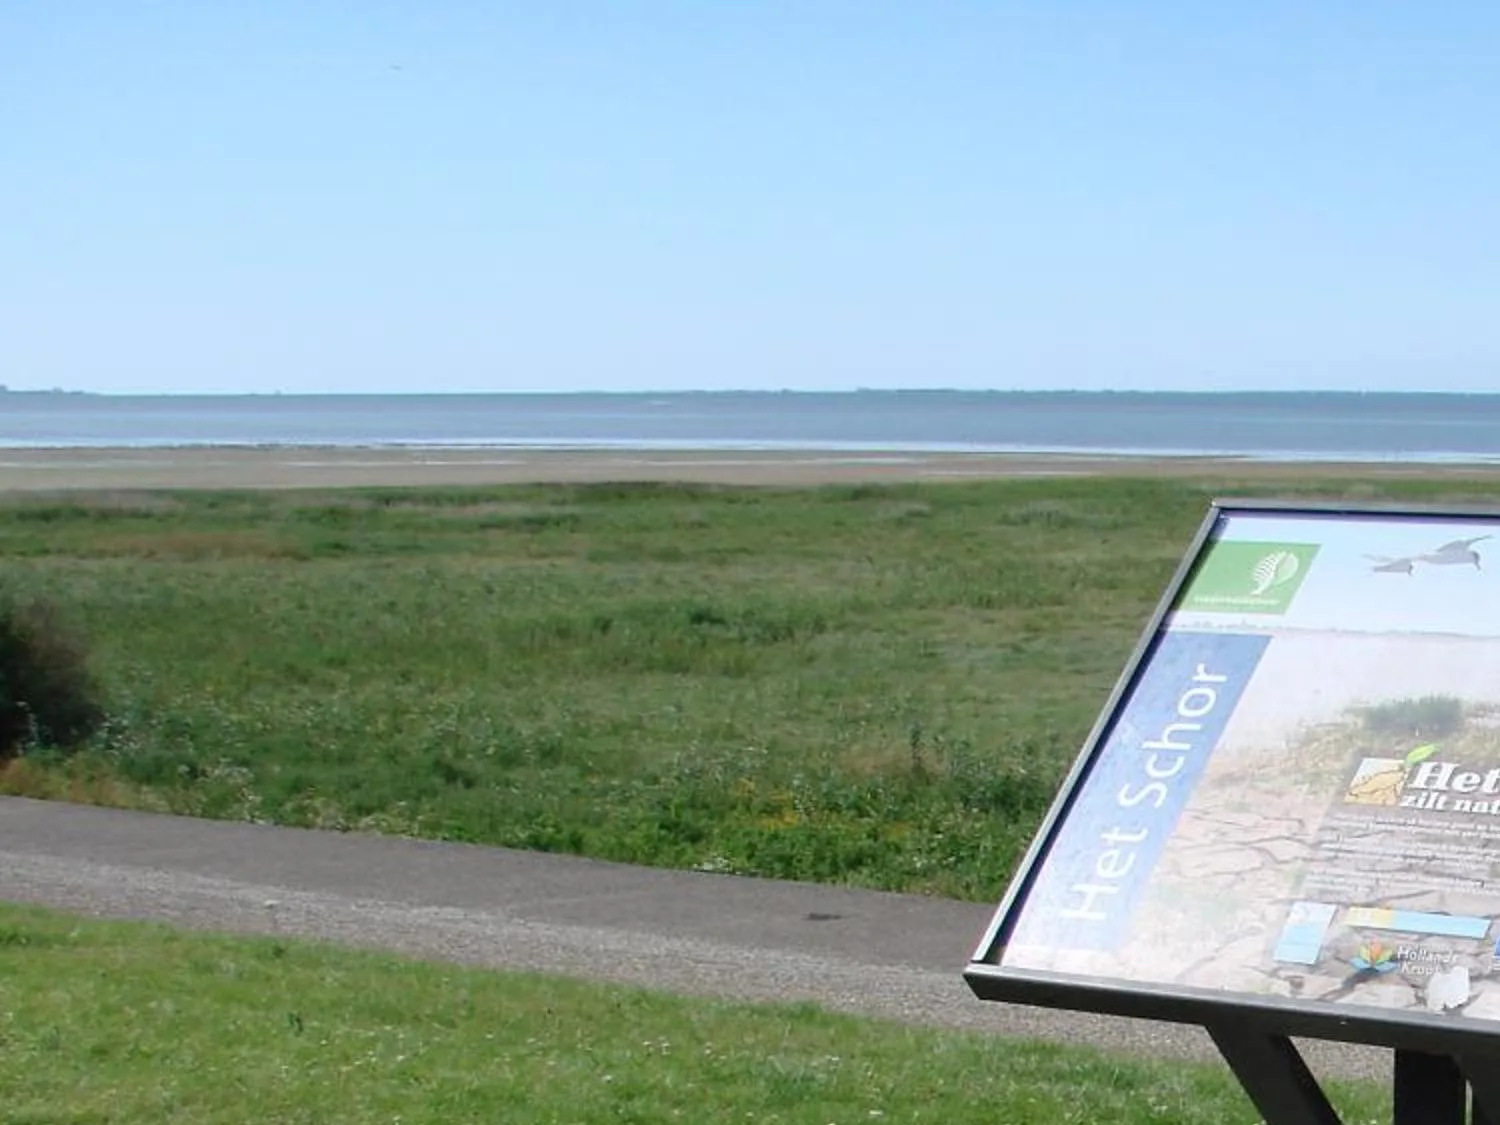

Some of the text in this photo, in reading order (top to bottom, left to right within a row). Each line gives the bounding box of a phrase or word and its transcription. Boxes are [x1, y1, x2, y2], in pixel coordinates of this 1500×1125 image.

[1059, 662, 1228, 921] Het Schor
[1400, 790, 1447, 810] zilt
